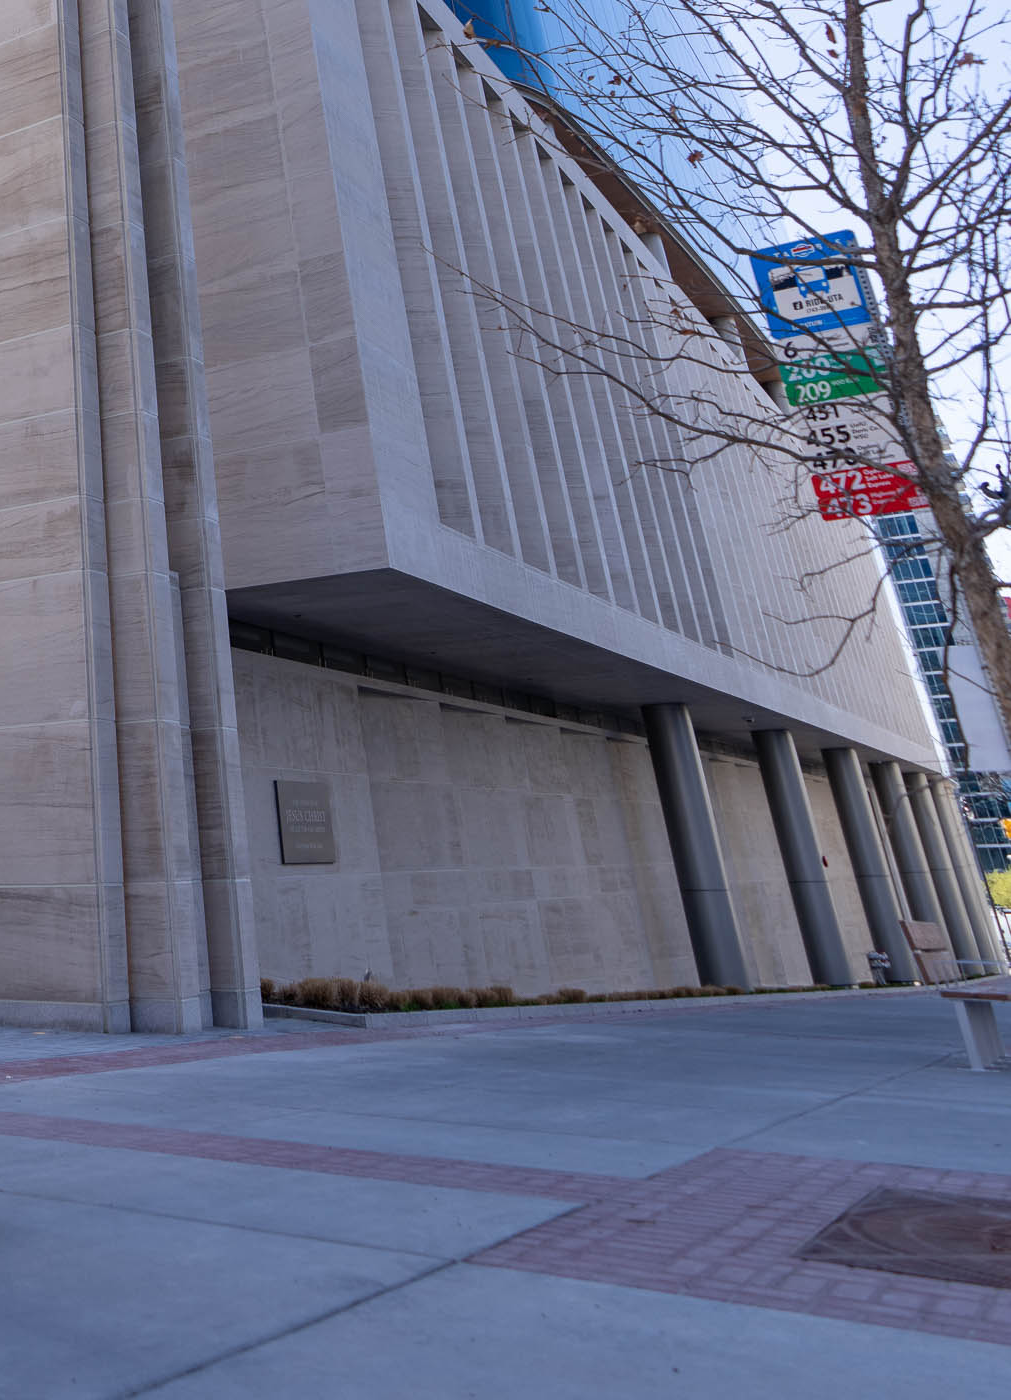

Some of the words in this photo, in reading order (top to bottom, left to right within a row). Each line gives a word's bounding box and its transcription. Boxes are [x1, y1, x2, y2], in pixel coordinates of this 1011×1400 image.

[784, 341, 797, 358] 6
[796, 380, 832, 403] 209
[806, 402, 839, 421] 451
[807, 425, 851, 446] 455
[820, 470, 866, 494] 472
[827, 493, 873, 517] 473
